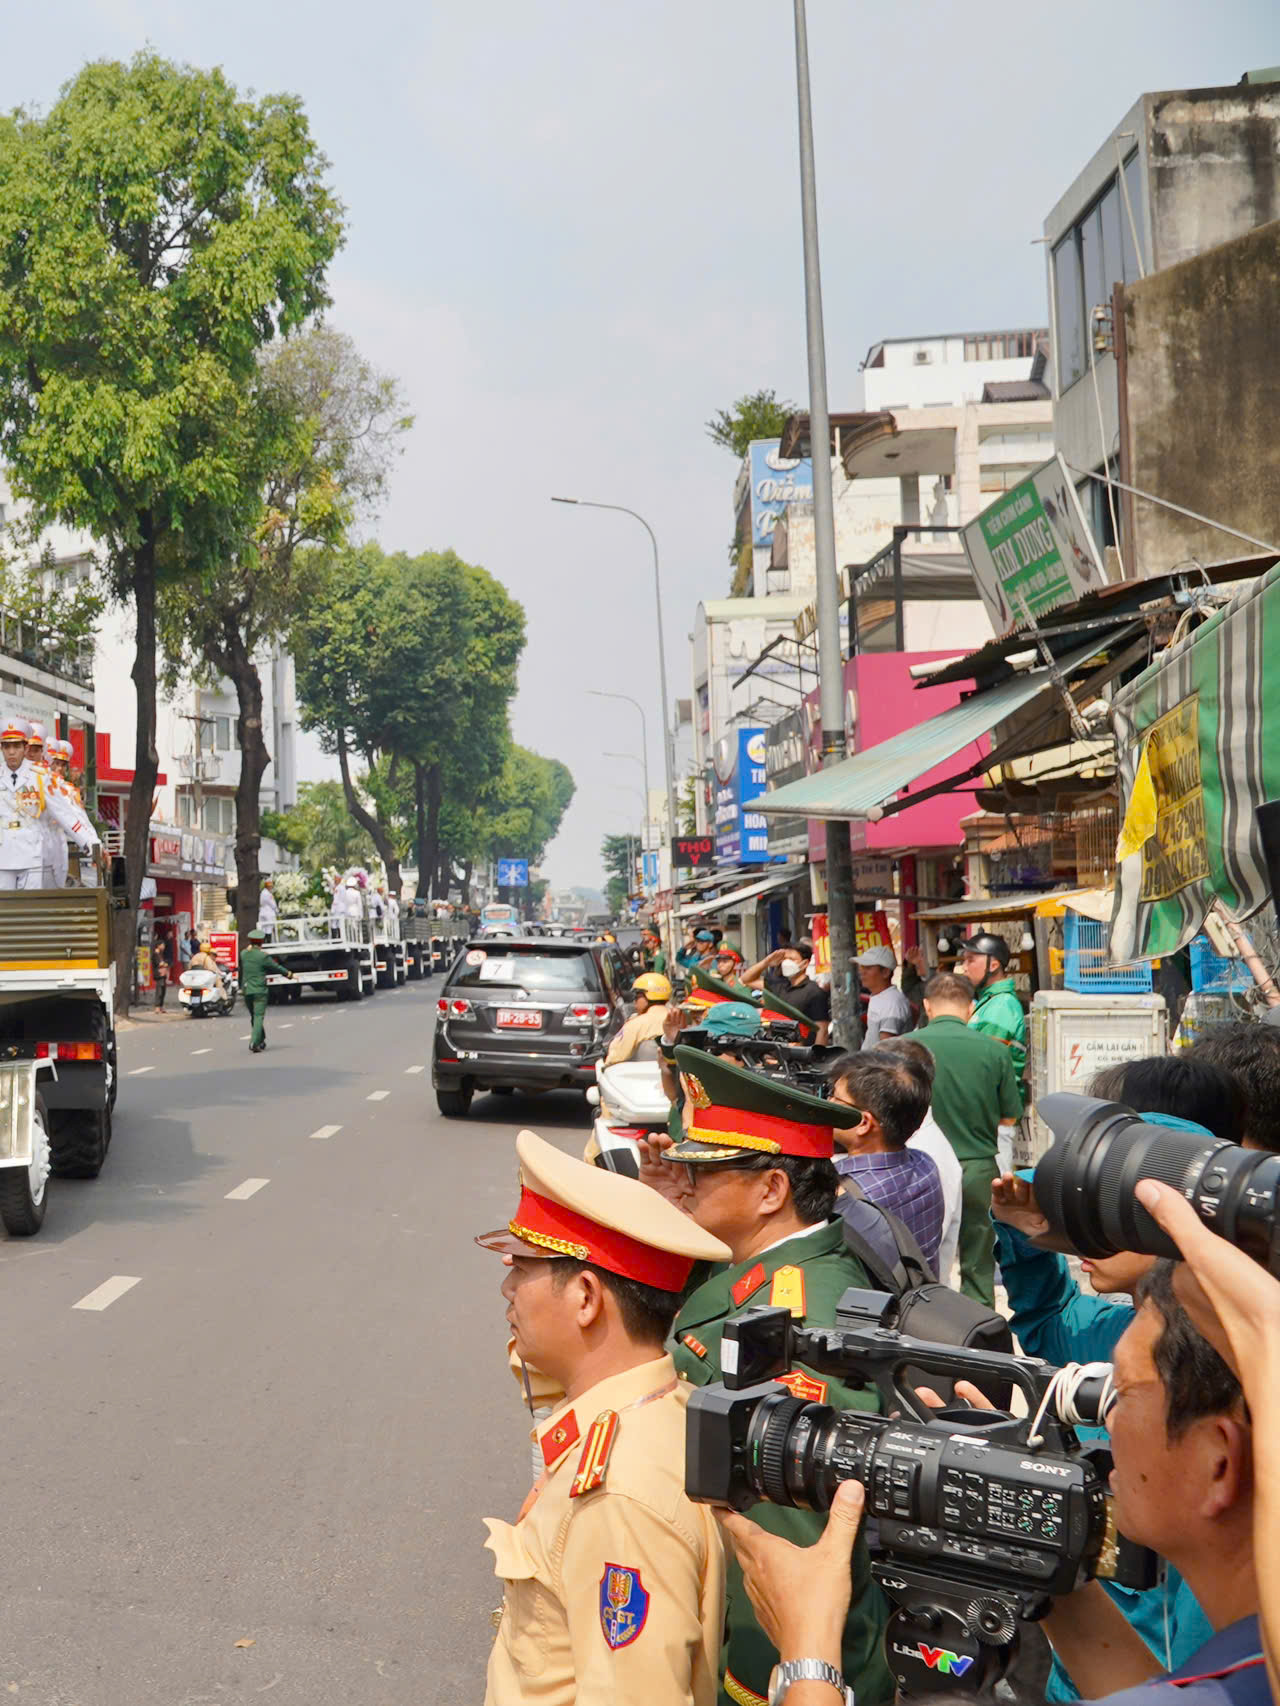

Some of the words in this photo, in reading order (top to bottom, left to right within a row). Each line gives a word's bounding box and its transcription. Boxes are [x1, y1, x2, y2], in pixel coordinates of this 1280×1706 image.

[991, 536, 1022, 582] KIM
[1013, 515, 1056, 568] DUNG
[751, 768, 766, 784] TH
[677, 838, 711, 853] THÚ
[690, 853, 701, 865] Y
[889, 1431, 914, 1443] 4K
[1020, 1459, 1072, 1477] SONY
[917, 1641, 974, 1677] VTV
